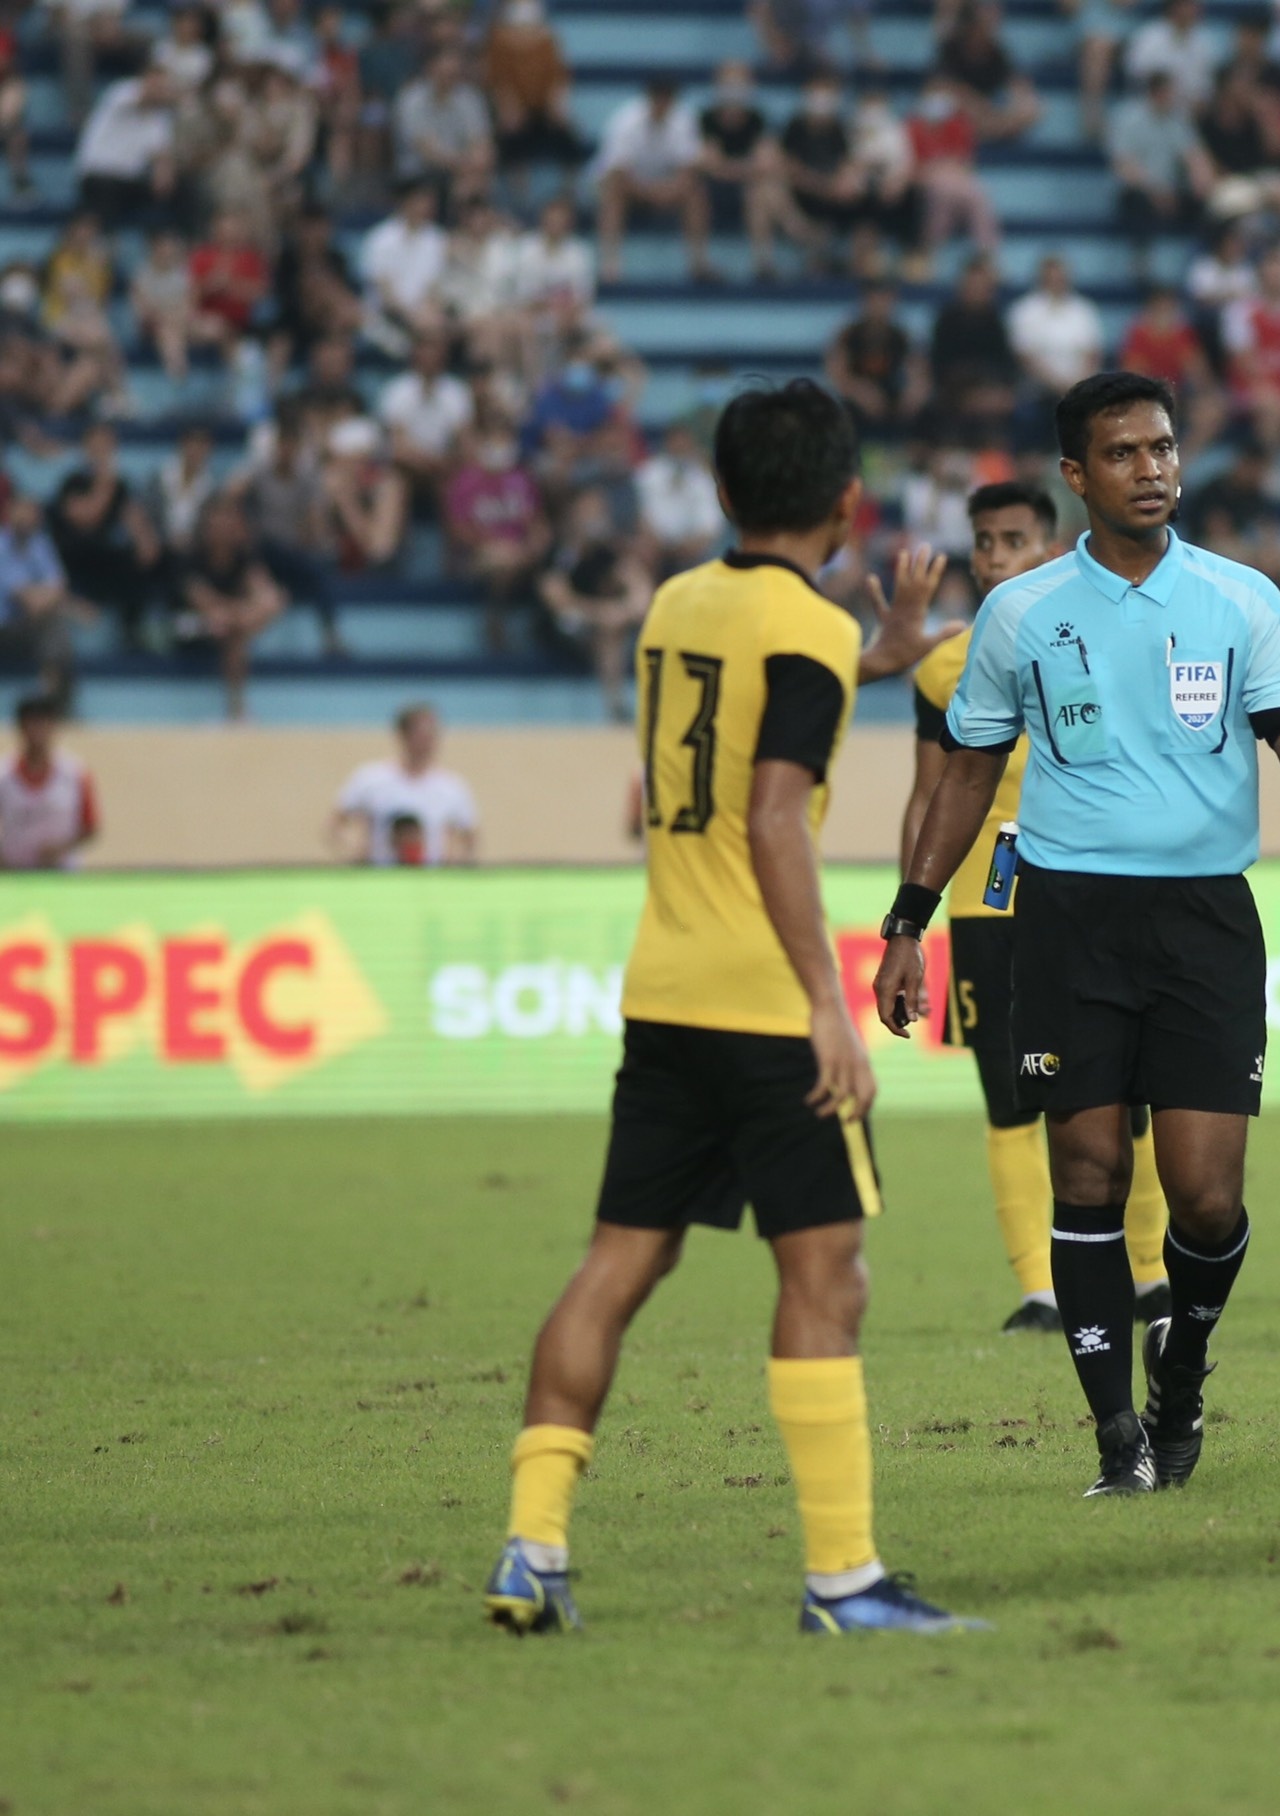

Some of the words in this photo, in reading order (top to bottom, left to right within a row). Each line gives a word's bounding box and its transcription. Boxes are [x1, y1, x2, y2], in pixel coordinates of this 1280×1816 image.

[1176, 665, 1217, 681] FIFA
[1175, 692, 1217, 701] REFEREE
[1053, 702, 1102, 727] AFC
[1187, 714, 1207, 723] 2022
[644, 648, 722, 835] 13
[1020, 1052, 1060, 1076] AFC
[1075, 1342, 1111, 1356] KELME
